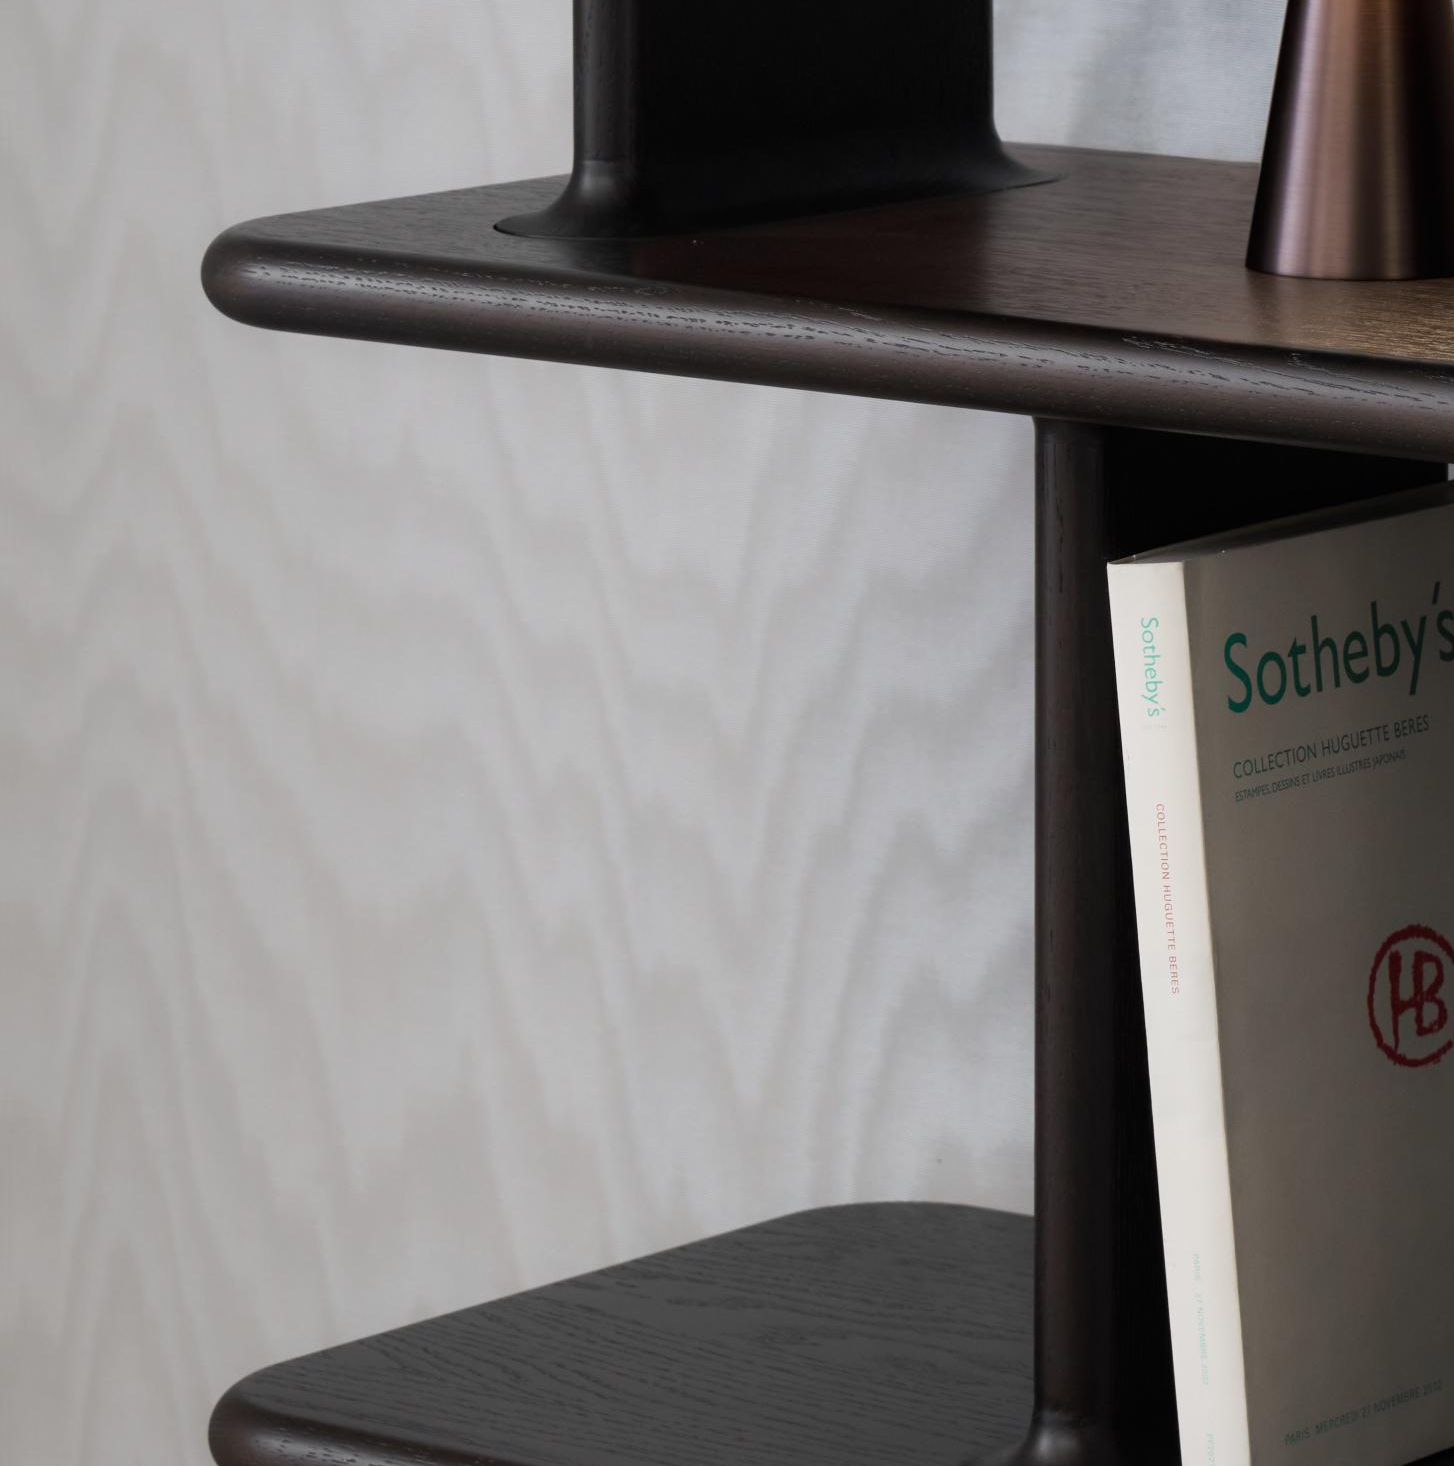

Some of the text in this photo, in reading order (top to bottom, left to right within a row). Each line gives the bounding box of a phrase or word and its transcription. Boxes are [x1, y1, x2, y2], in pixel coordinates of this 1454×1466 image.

[1141, 617, 1165, 719] Sotheby's
[1232, 713, 1430, 780] COLLECTION HUGUETTE BERES
[1155, 802, 1180, 995] COLLECTION HUGUETTE BERES
